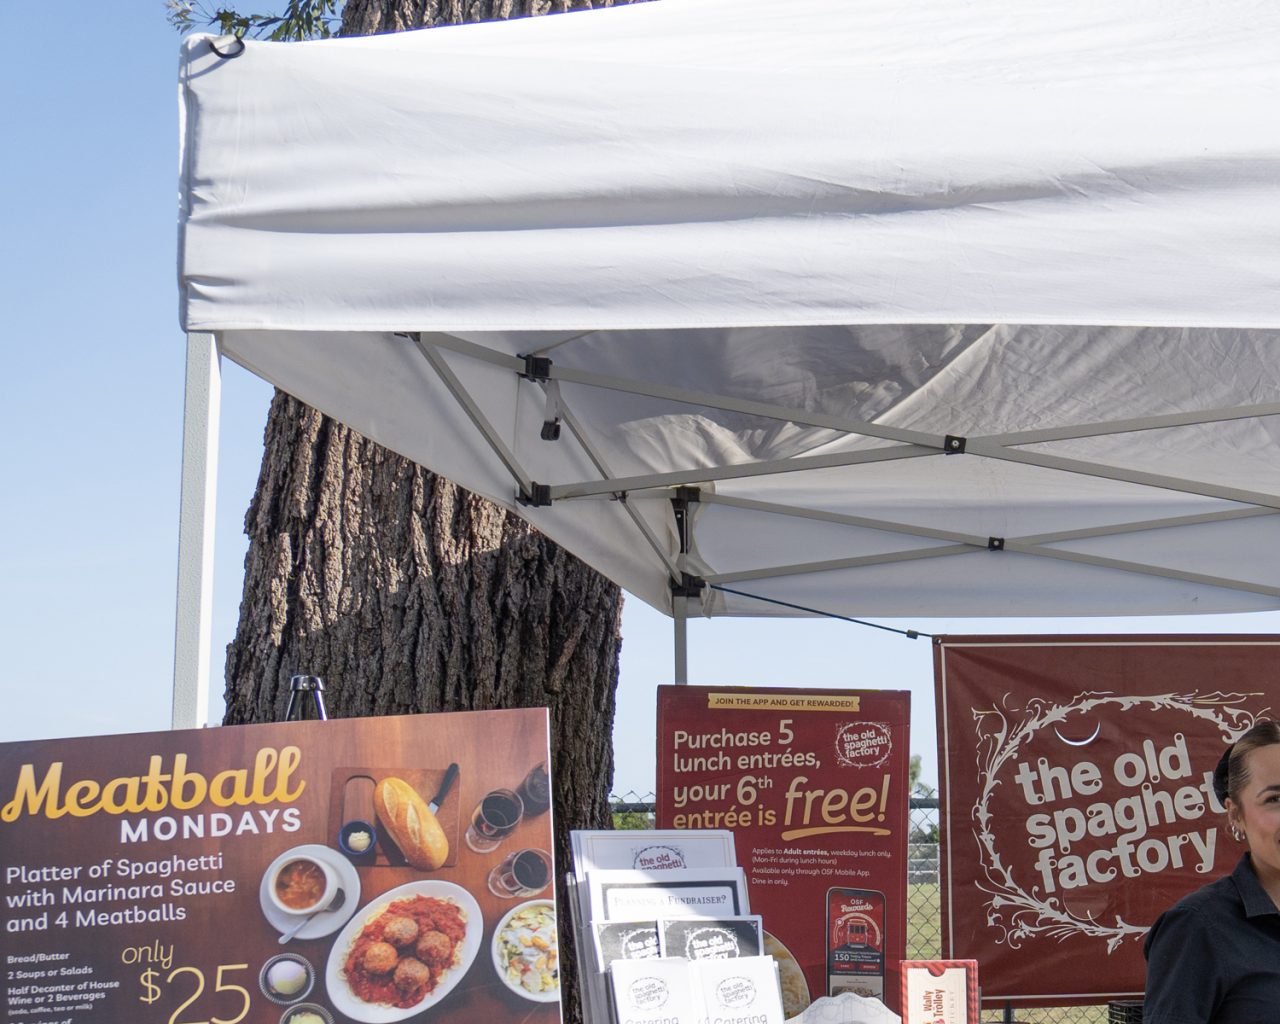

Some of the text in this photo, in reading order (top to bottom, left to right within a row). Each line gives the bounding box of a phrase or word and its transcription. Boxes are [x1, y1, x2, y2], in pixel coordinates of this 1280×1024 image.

[715, 697, 854, 708] JOIN THE APP AND GET REWARDED!
[674, 719, 794, 750] Purchase 5
[843, 729, 876, 743] the old
[844, 736, 888, 750] spaghetti
[674, 748, 821, 773] lunch entrées,
[845, 747, 880, 759] factory
[1, 746, 306, 822] Meatball
[1015, 732, 1191, 808] the old
[673, 776, 773, 808] your 6th
[784, 774, 891, 826] free!
[120, 808, 301, 843] MONDAYS
[672, 804, 777, 830] entrée is
[1025, 771, 1228, 853] spaghet
[6, 852, 223, 884] Platter of Spaghetti
[639, 857, 655, 867] the
[656, 853, 670, 862] old
[1034, 823, 1217, 895] factory
[5, 879, 236, 908] with Marinara Sauce
[6, 904, 187, 932] and 4 Meatballs
[7, 953, 70, 964] Bread/Butter
[121, 939, 174, 969] only
[16, 970, 46, 979] Soups
[48, 969, 58, 977] or
[60, 966, 93, 976] Salads
[923, 990, 935, 1012] Wally
